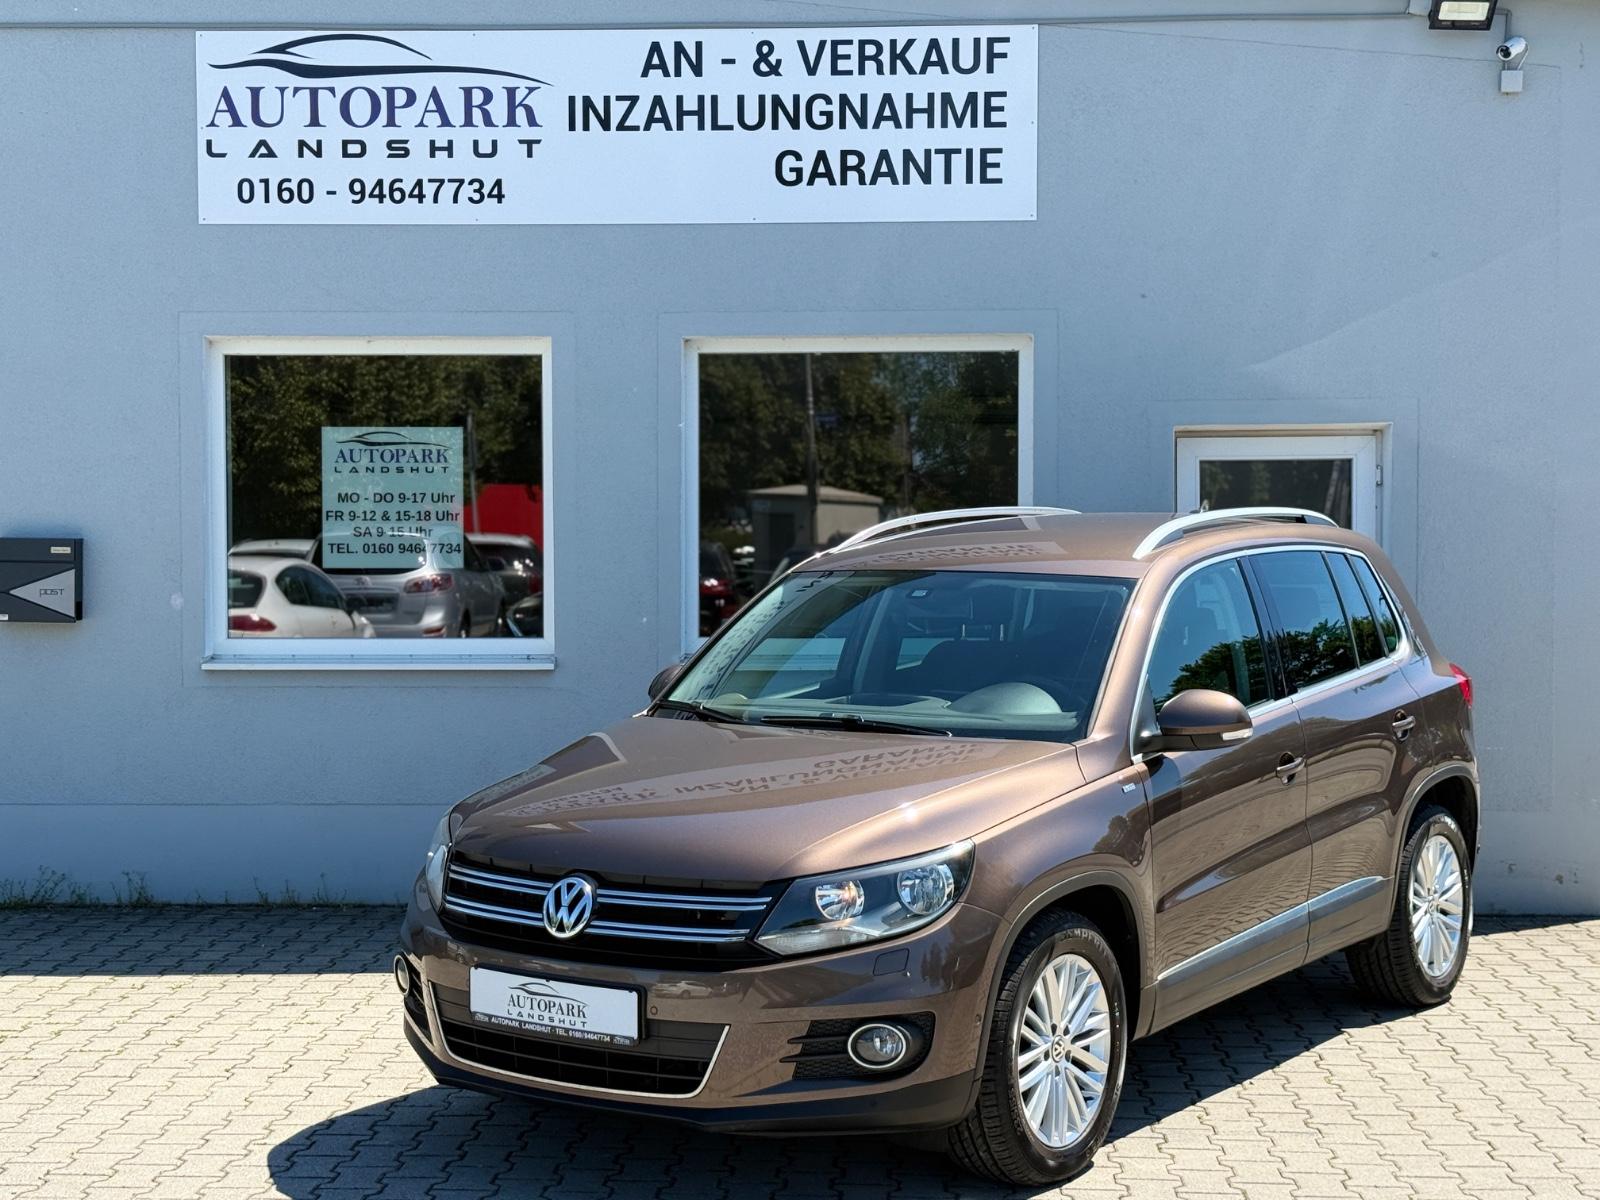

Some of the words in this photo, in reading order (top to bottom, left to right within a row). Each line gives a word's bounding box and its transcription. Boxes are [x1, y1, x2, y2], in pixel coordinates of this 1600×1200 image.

[640, 40, 703, 78] AN
[720, 57, 736, 65] -
[752, 39, 783, 78] &
[796, 36, 1011, 77] VERKAUF
[205, 85, 544, 129] AUTOPARK
[567, 90, 1008, 132] INZAHLUNGNAHME
[205, 138, 543, 159] LANDSHUT
[774, 147, 1004, 187] GARANTIE
[237, 177, 315, 204] 0160
[348, 177, 505, 204] 94647734
[334, 448, 449, 464] AUTOPARK
[334, 466, 449, 474] LANDSHUT
[337, 492, 360, 504] MO
[373, 492, 394, 504] DO
[398, 492, 426, 504] 9-17
[431, 492, 455, 504] Uhr
[325, 510, 345, 522] FR
[348, 510, 377, 522] 9-12
[381, 510, 391, 522] &
[395, 510, 431, 522] 15-18
[435, 510, 460, 522] Uhr
[353, 526, 372, 538] SA
[409, 526, 433, 538] Uhr
[328, 543, 359, 554] TEL.
[363, 543, 394, 554] 0160
[507, 993, 587, 1019] AUTOPARK
[491, 1016, 520, 1028] AUTOPARK
[522, 1022, 551, 1034] LANDSHUT
[507, 1009, 588, 1028] LANDSHUT
